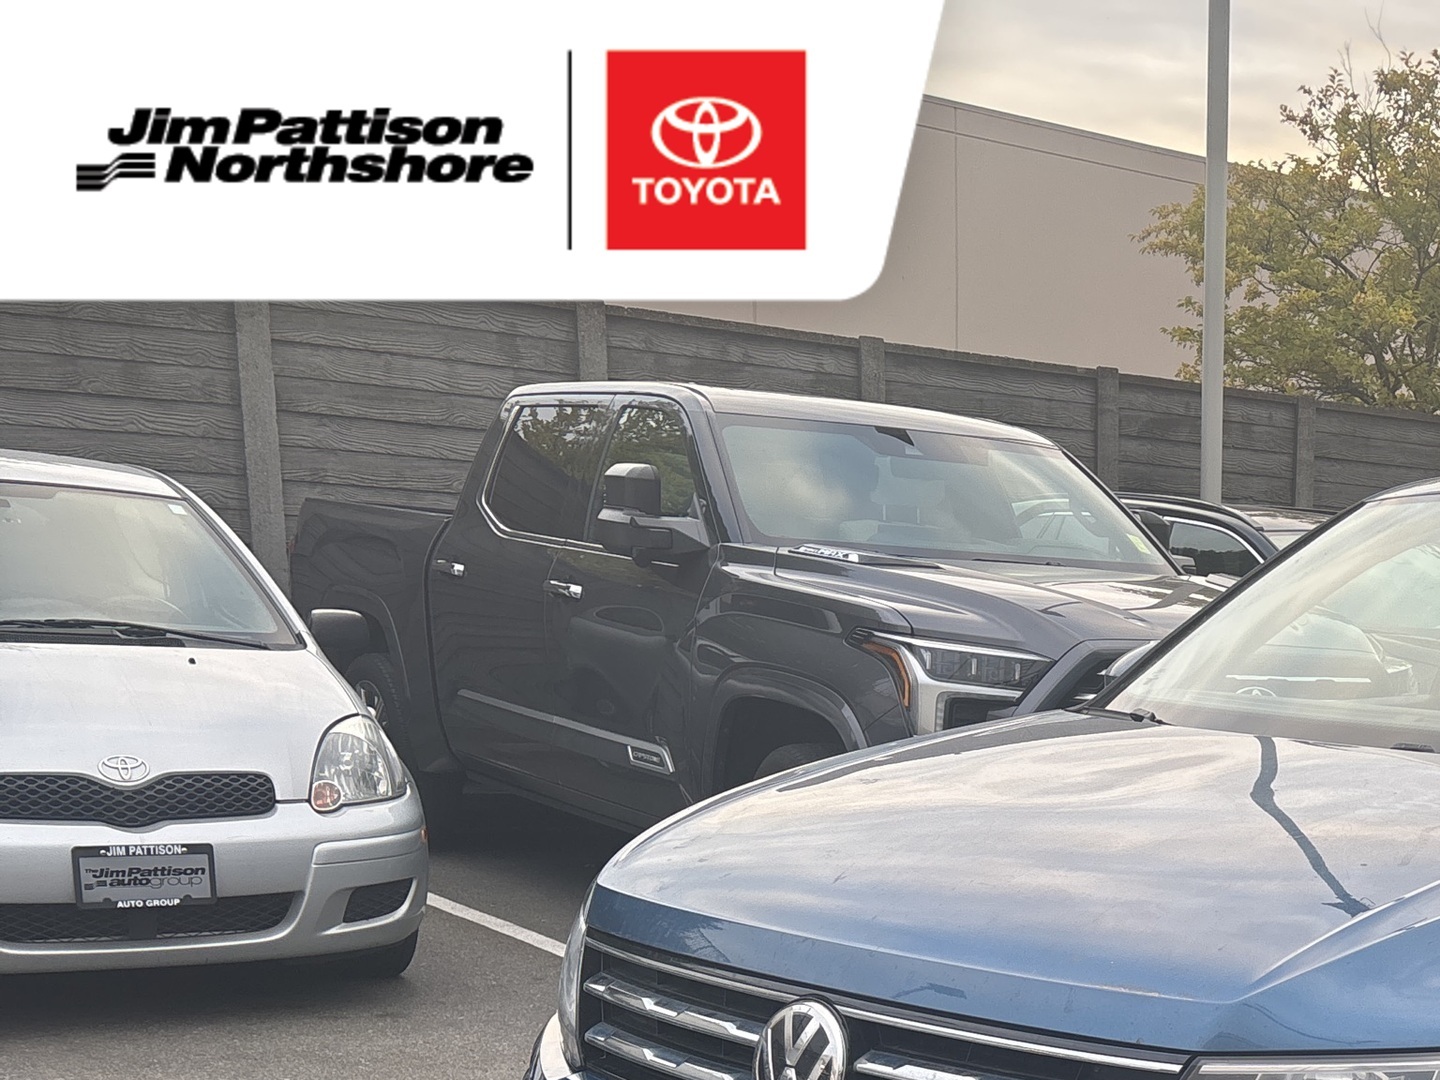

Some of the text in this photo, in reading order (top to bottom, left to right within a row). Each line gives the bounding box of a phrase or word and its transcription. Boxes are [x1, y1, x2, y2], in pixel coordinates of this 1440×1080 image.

[106, 844, 182, 857] JIM PATTISON
[117, 898, 181, 908] AUTO GROUP
